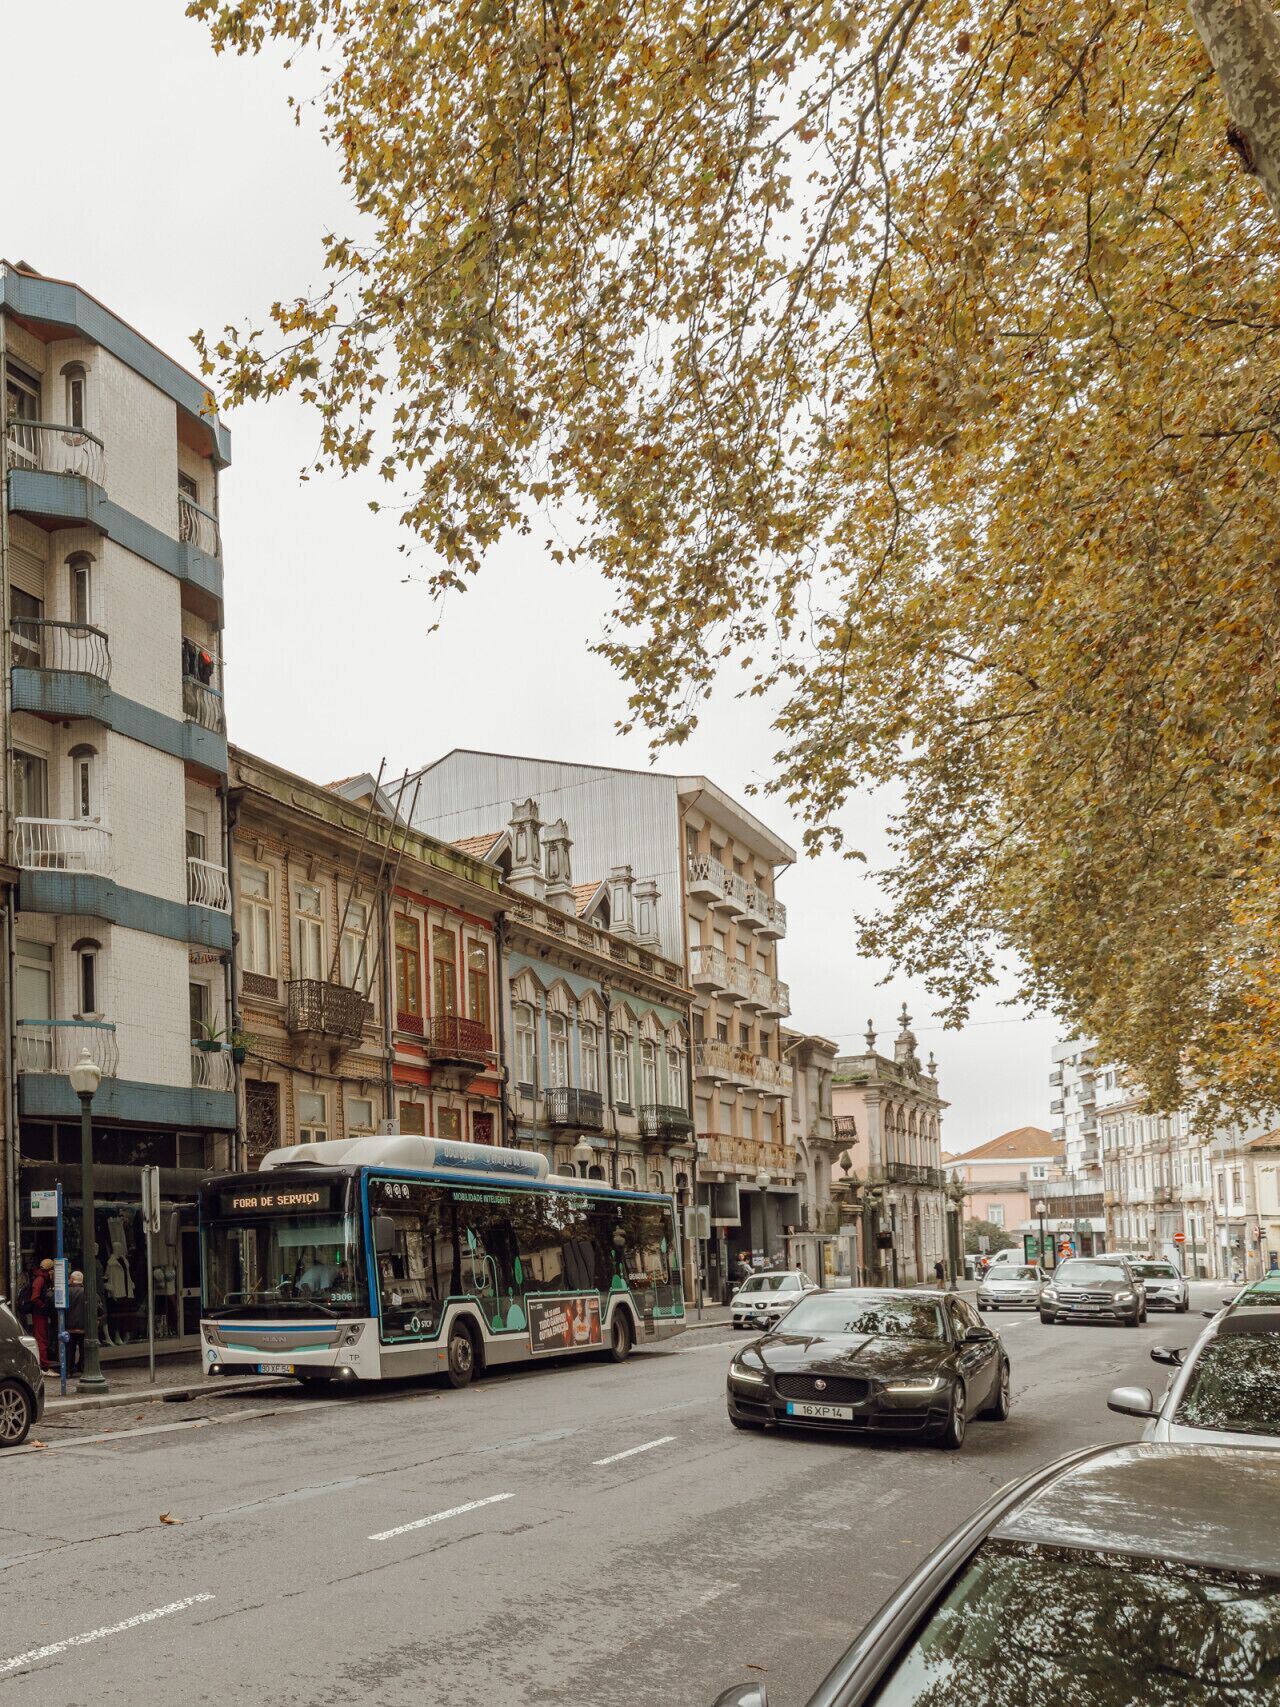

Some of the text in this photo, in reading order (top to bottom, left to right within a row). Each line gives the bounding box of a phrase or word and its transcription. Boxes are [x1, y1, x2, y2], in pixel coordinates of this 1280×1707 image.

[233, 1193, 319, 1209] FORA DE SERVIÇO
[453, 1193, 511, 1204] MOBILIDADE INTELIGENTE
[331, 1293, 352, 1301] 3306
[421, 1320, 432, 1328] STCP
[803, 1405, 842, 1418] 16 XP 14
